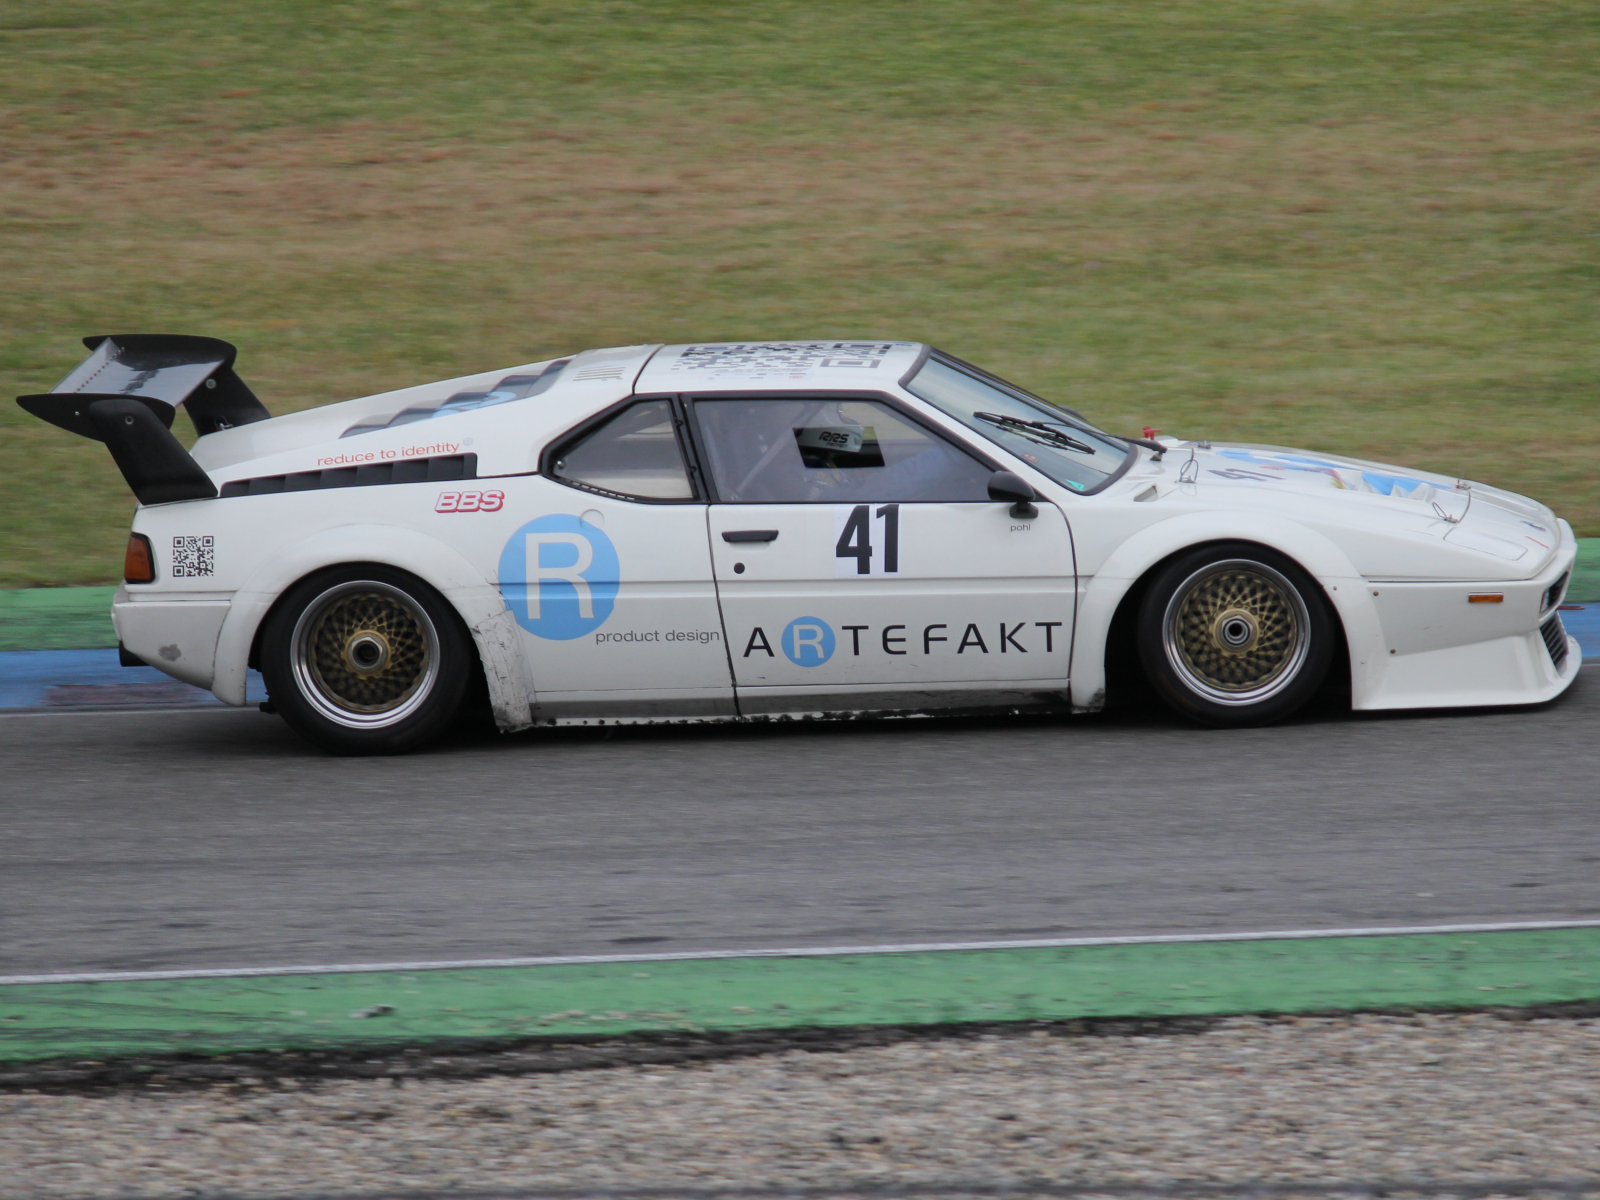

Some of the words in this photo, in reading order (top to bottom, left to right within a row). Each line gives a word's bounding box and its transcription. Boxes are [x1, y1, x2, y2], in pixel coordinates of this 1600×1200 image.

[819, 431, 849, 444] RRS
[317, 452, 375, 466] reduce
[380, 449, 396, 459] to
[401, 442, 460, 457] identity
[434, 490, 505, 513] BBS
[836, 504, 899, 574] 41
[1010, 523, 1031, 532] pohl
[525, 532, 595, 619] R
[595, 630, 660, 645] product
[665, 629, 720, 644] design
[743, 621, 1063, 659] ARTEFAKT
